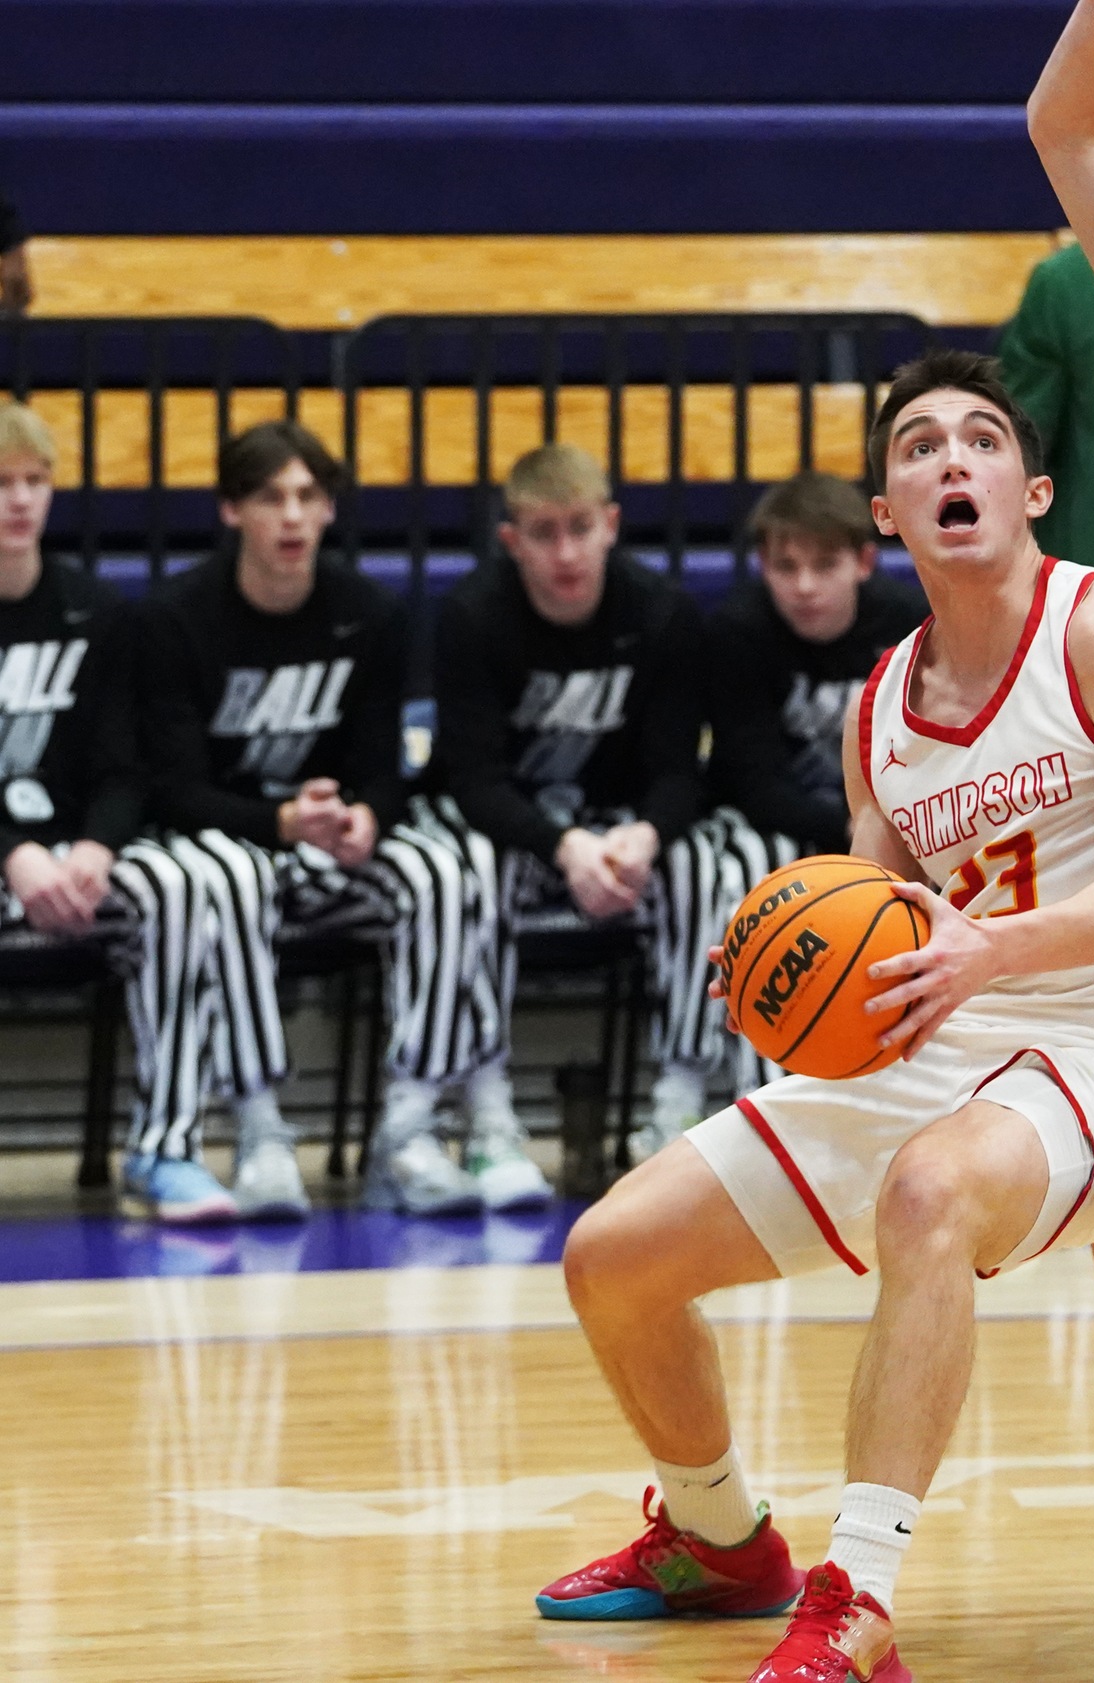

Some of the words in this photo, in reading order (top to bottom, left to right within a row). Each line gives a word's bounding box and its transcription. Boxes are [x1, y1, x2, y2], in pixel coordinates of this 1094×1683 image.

[0, 637, 89, 714] ALL
[211, 657, 354, 736] BALL
[512, 663, 634, 732] BALL
[892, 752, 1072, 858] SIMPSON
[721, 880, 808, 996] Wilson
[753, 928, 829, 1027] NCAA
